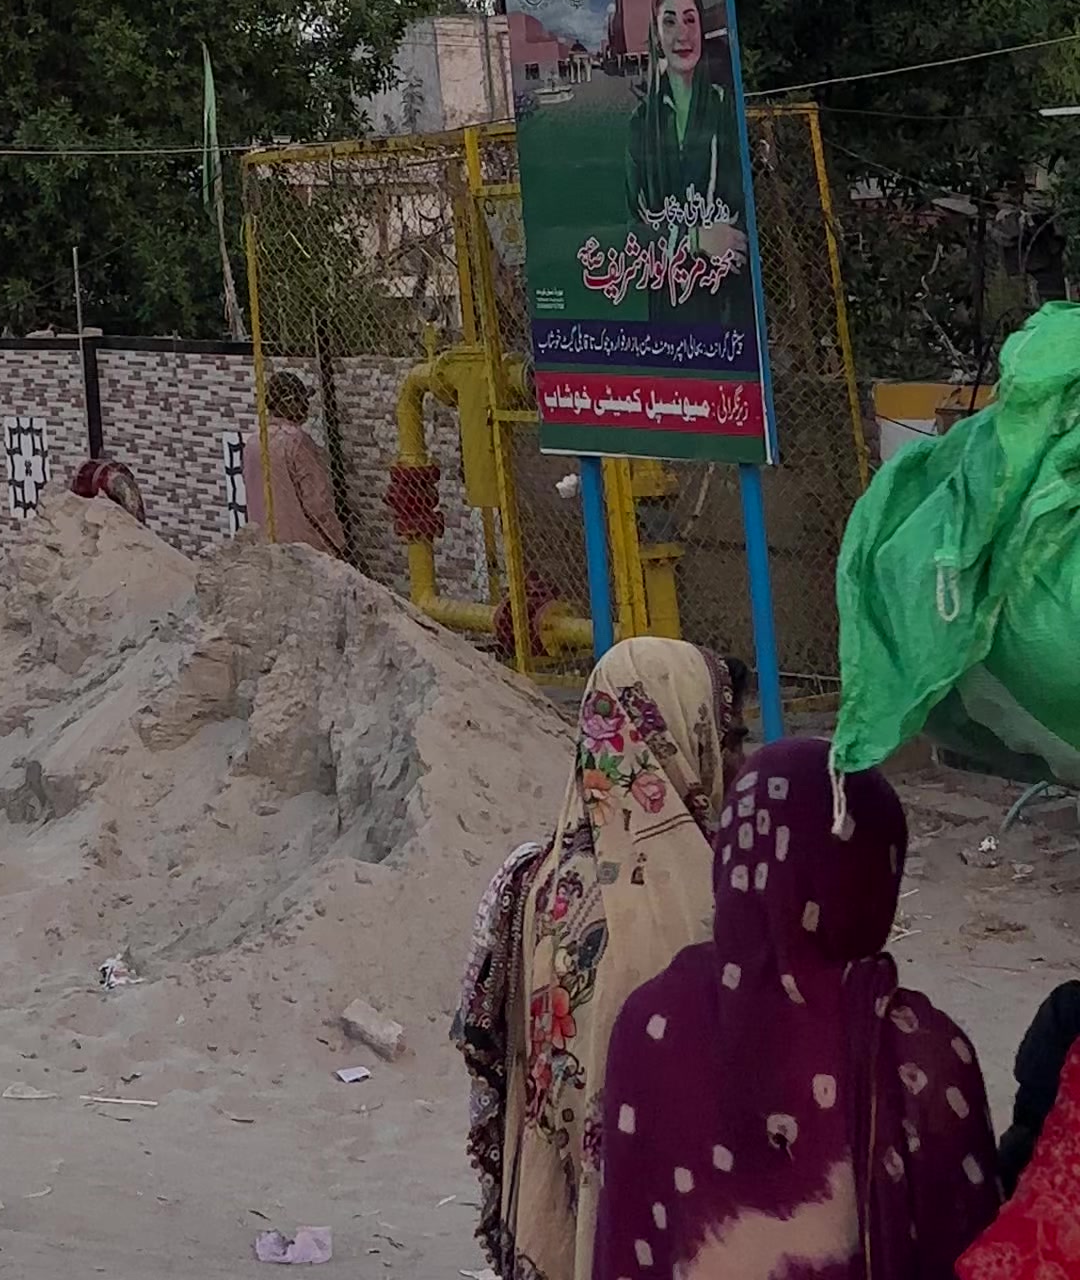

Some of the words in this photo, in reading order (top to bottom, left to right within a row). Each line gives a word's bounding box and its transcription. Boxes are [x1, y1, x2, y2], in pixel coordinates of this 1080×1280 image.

[646, 194, 684, 231] پنجاب
[576, 237, 605, 270] صاحبہ
[583, 232, 641, 305] شریف
[635, 236, 668, 289] نواز
[668, 235, 707, 307] مریم
[699, 248, 734, 295] محترمہ
[538, 328, 561, 354] خوشاب
[544, 383, 591, 415] خوشاب
[594, 385, 642, 416] کمیٹی
[645, 389, 711, 424] میونسپل
